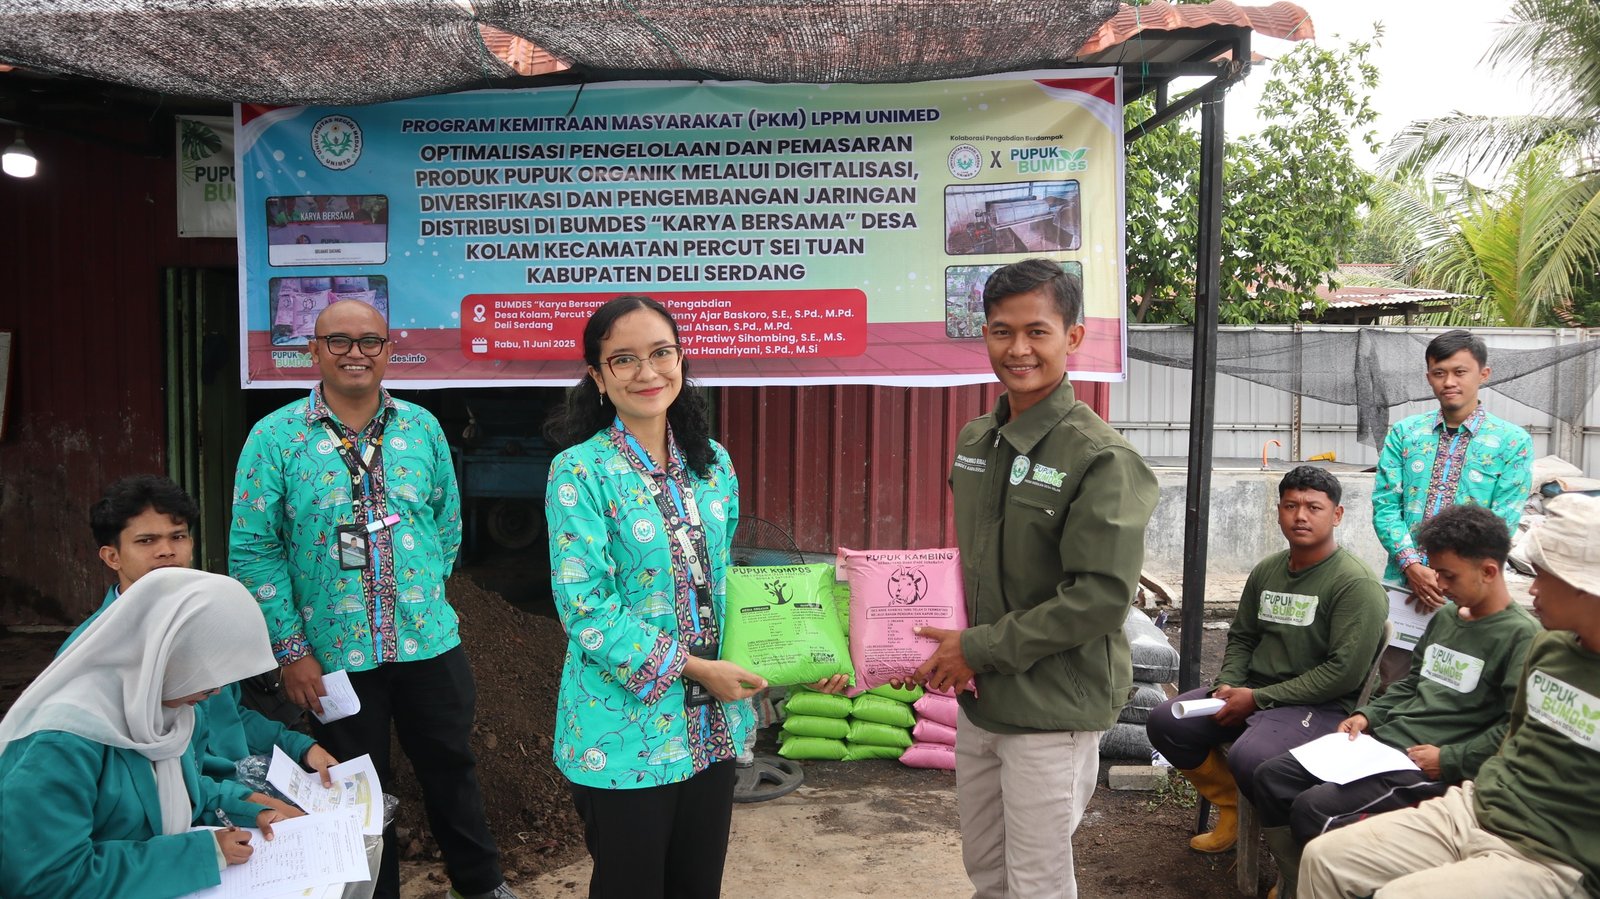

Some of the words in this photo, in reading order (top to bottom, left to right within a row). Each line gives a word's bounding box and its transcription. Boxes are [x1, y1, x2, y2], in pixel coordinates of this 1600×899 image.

[402, 118, 495, 133] PROGRAM
[500, 116, 607, 132] KEMITRAAN
[612, 113, 743, 130] MASYARAKAT
[749, 108, 806, 130] (PKM)
[812, 111, 860, 126] LPPM
[866, 109, 940, 124] UNIMED
[314, 118, 333, 154] UNIVERSITAS
[334, 118, 356, 130] NEGERI
[1025, 134, 1064, 142] Berdampak
[421, 144, 564, 162] OPTIMALISASI
[570, 141, 720, 160] PENGELOLAAN
[726, 140, 771, 156] DAN
[778, 136, 912, 154] PEMASARAN
[1011, 147, 1058, 160] PUPUK
[990, 150, 1002, 168] X
[1018, 159, 1087, 173] BUMDes
[416, 168, 500, 187] PRODUK
[504, 167, 573, 184] PUPUK
[578, 164, 676, 183] ORGANIK
[682, 163, 770, 180] MELALUI
[775, 160, 918, 180] DIGITALISASI,
[204, 184, 236, 202] BU
[420, 192, 562, 212] DIVERSIFIKASI
[568, 191, 612, 209] DAN
[618, 187, 798, 207] PENGEMBANGAN
[803, 187, 916, 205] JARINGAN
[300, 212, 321, 221] KARYA
[322, 212, 354, 220] BERSAMA
[421, 218, 529, 237] DISTRIBUSI
[535, 217, 555, 234] DI
[560, 216, 646, 234] BUMDES
[651, 213, 736, 232] “KARYA
[741, 213, 855, 231] BERSAMA”
[862, 213, 917, 230] DESA
[467, 242, 539, 261] KOLAM
[545, 240, 678, 259] KECAMATAN
[683, 239, 764, 257] PERCUT
[770, 238, 800, 255] SEI
[805, 238, 864, 254] TUAN
[527, 266, 652, 284] KABUPATEN
[657, 265, 699, 282] DELI
[704, 264, 806, 281] SERDANG
[534, 300, 567, 310] “Karya
[668, 299, 731, 310] Pengabdian
[520, 311, 552, 319] Kolam,
[672, 313, 697, 322] anny
[700, 311, 721, 322] Ajar
[724, 310, 770, 320] Baskoro,
[772, 310, 792, 319] S.E.,
[794, 309, 822, 318] S.Pd.,
[826, 309, 854, 317] M.Pd.
[495, 321, 512, 329] Deli
[514, 321, 553, 330] Serdang
[695, 323, 731, 332] Ahsan,
[734, 322, 761, 332] S.Pd.,
[765, 322, 793, 330] M.Pd.
[495, 341, 521, 349] Rabu,
[696, 334, 736, 344] Pratiwy
[738, 333, 797, 344] Sihombing,
[801, 333, 822, 342] S.E.,
[825, 332, 846, 341] M.S.
[701, 346, 763, 357] Handriyani,
[765, 346, 794, 355] S.Pd.,
[796, 344, 818, 354] M.Si
[1533, 674, 1579, 707] PUPUK
[1541, 695, 1596, 736] BUMDes
